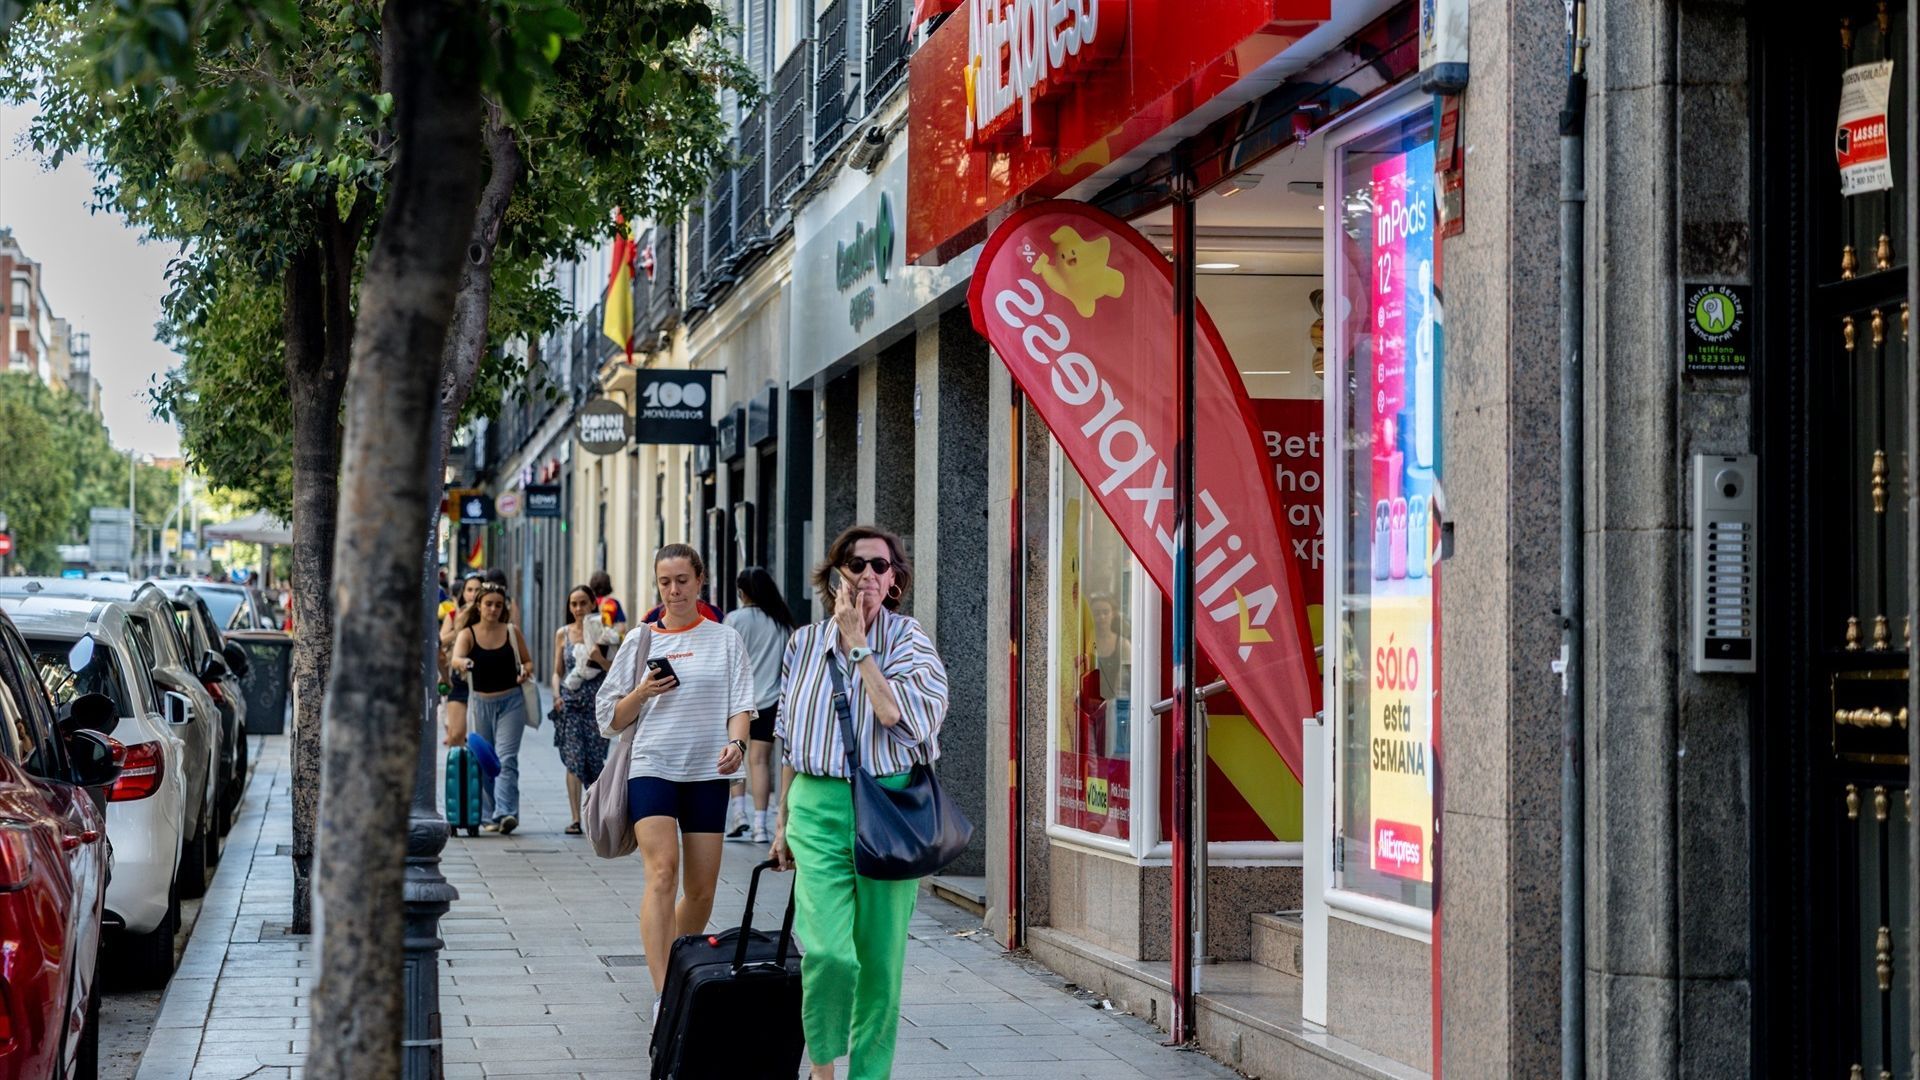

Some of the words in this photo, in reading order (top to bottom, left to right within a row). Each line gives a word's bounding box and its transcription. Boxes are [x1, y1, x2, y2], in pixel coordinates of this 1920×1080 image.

[1853, 123, 1885, 142] LASSER
[1378, 197, 1426, 247] inPods
[1378, 252, 1391, 294] 12
[642, 381, 707, 408] 100
[580, 414, 624, 430] KONNI
[581, 429, 626, 442] CHIWA
[1263, 431, 1324, 458] Bet
[1276, 464, 1320, 492] ho
[1284, 504, 1324, 536] ay
[1292, 538, 1324, 570] xp
[1376, 632, 1419, 691] SÓLO
[1383, 699, 1411, 733] esta
[1372, 737, 1425, 777] SEMANA
[1377, 829, 1420, 868] AliExpress
